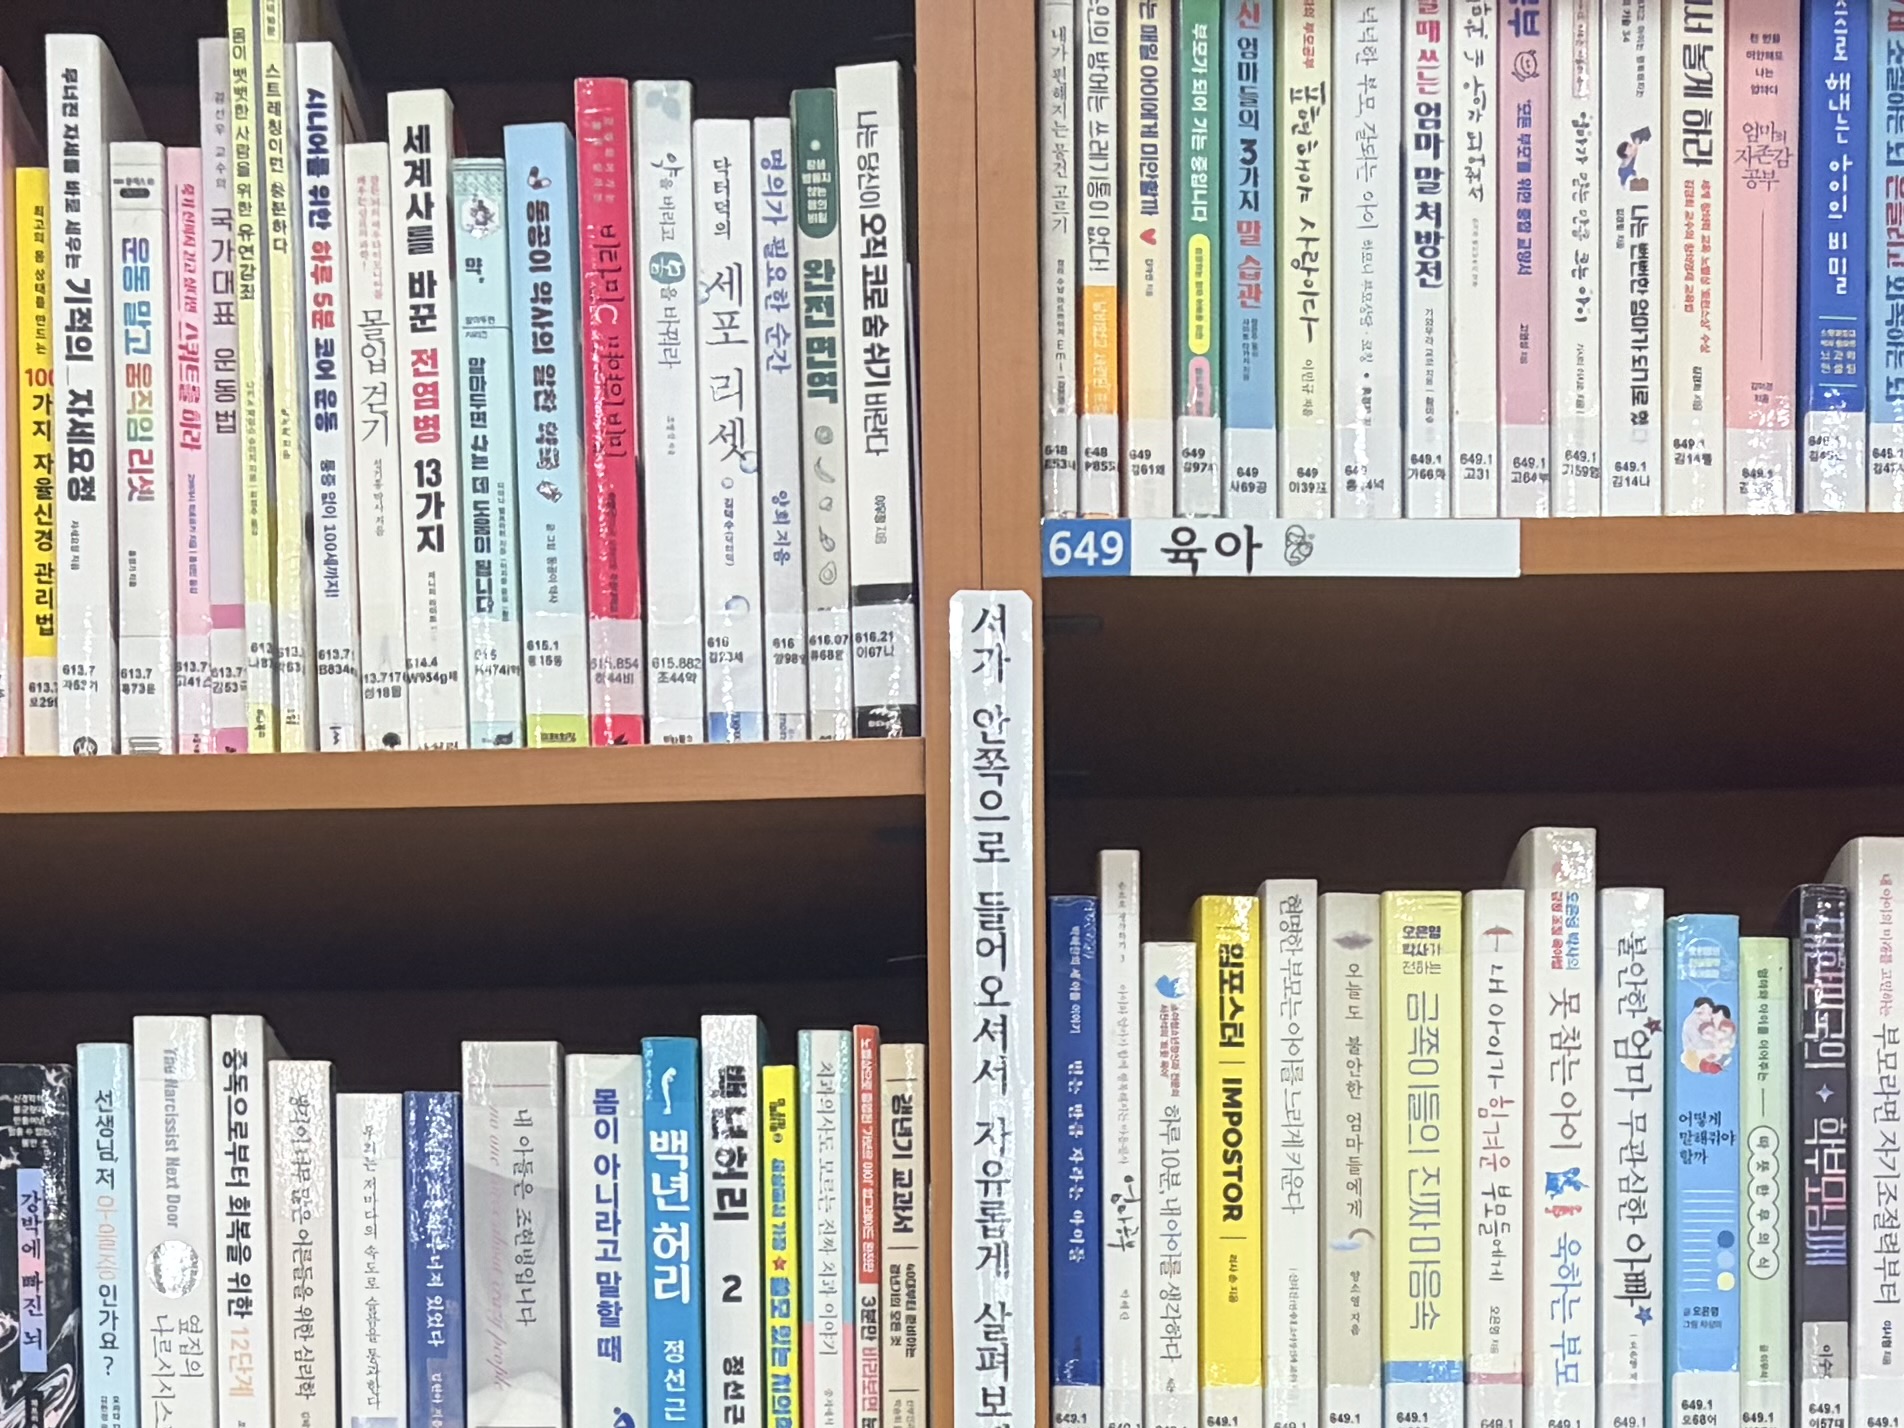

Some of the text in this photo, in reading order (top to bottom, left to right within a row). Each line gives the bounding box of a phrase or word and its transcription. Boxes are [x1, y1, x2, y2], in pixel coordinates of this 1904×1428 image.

[1735, 145, 1794, 169] 자존감
[1743, 121, 1787, 145] 엄마의
[1742, 169, 1780, 192] 공부
[403, 124, 445, 552] 세계사를 바꾼 전염병 13가지
[1614, 462, 1646, 472] 649.1
[1049, 524, 1262, 574] 649 육아
[971, 604, 1011, 684] 서가
[972, 704, 1011, 864] 안쪽으로
[972, 890, 1012, 1097] 들어오셔서
[1219, 944, 1244, 1221] 임포스터 IMPOSTOR
[973, 1116, 1013, 1280] 자유롭게
[1681, 1400, 1713, 1410] 649.1
